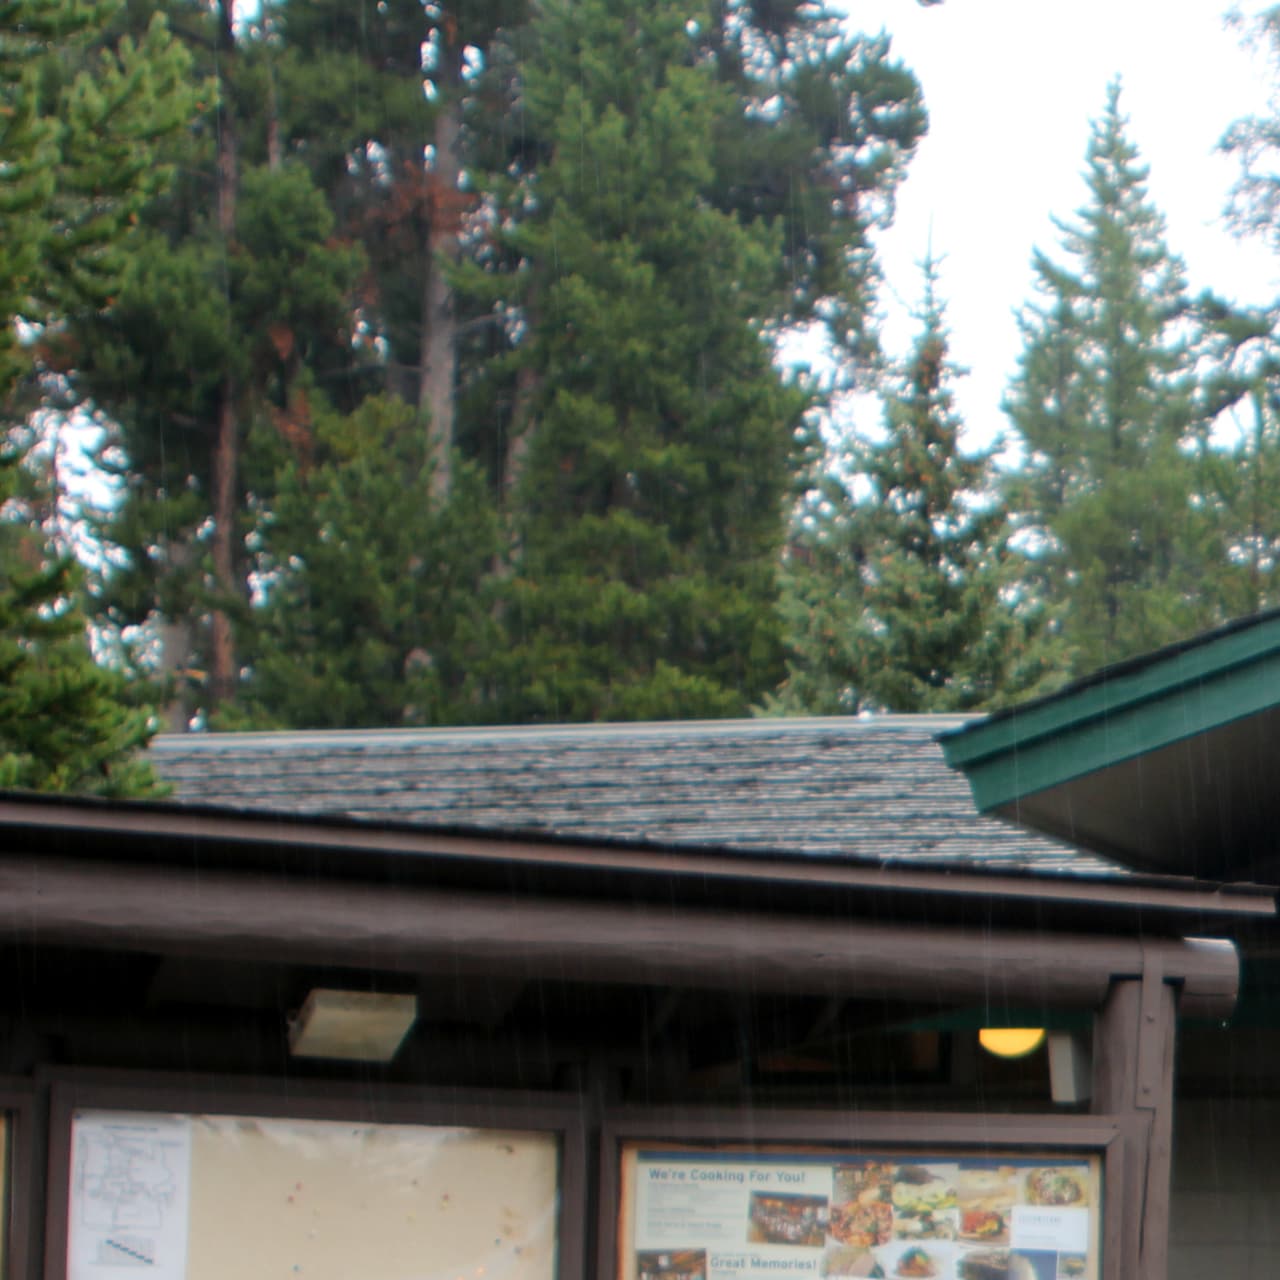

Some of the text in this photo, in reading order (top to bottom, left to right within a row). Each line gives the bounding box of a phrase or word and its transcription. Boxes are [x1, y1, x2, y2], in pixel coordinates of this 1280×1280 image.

[649, 1168, 805, 1184] We're Cooking For You!
[711, 1256, 817, 1271] Great Memories!
